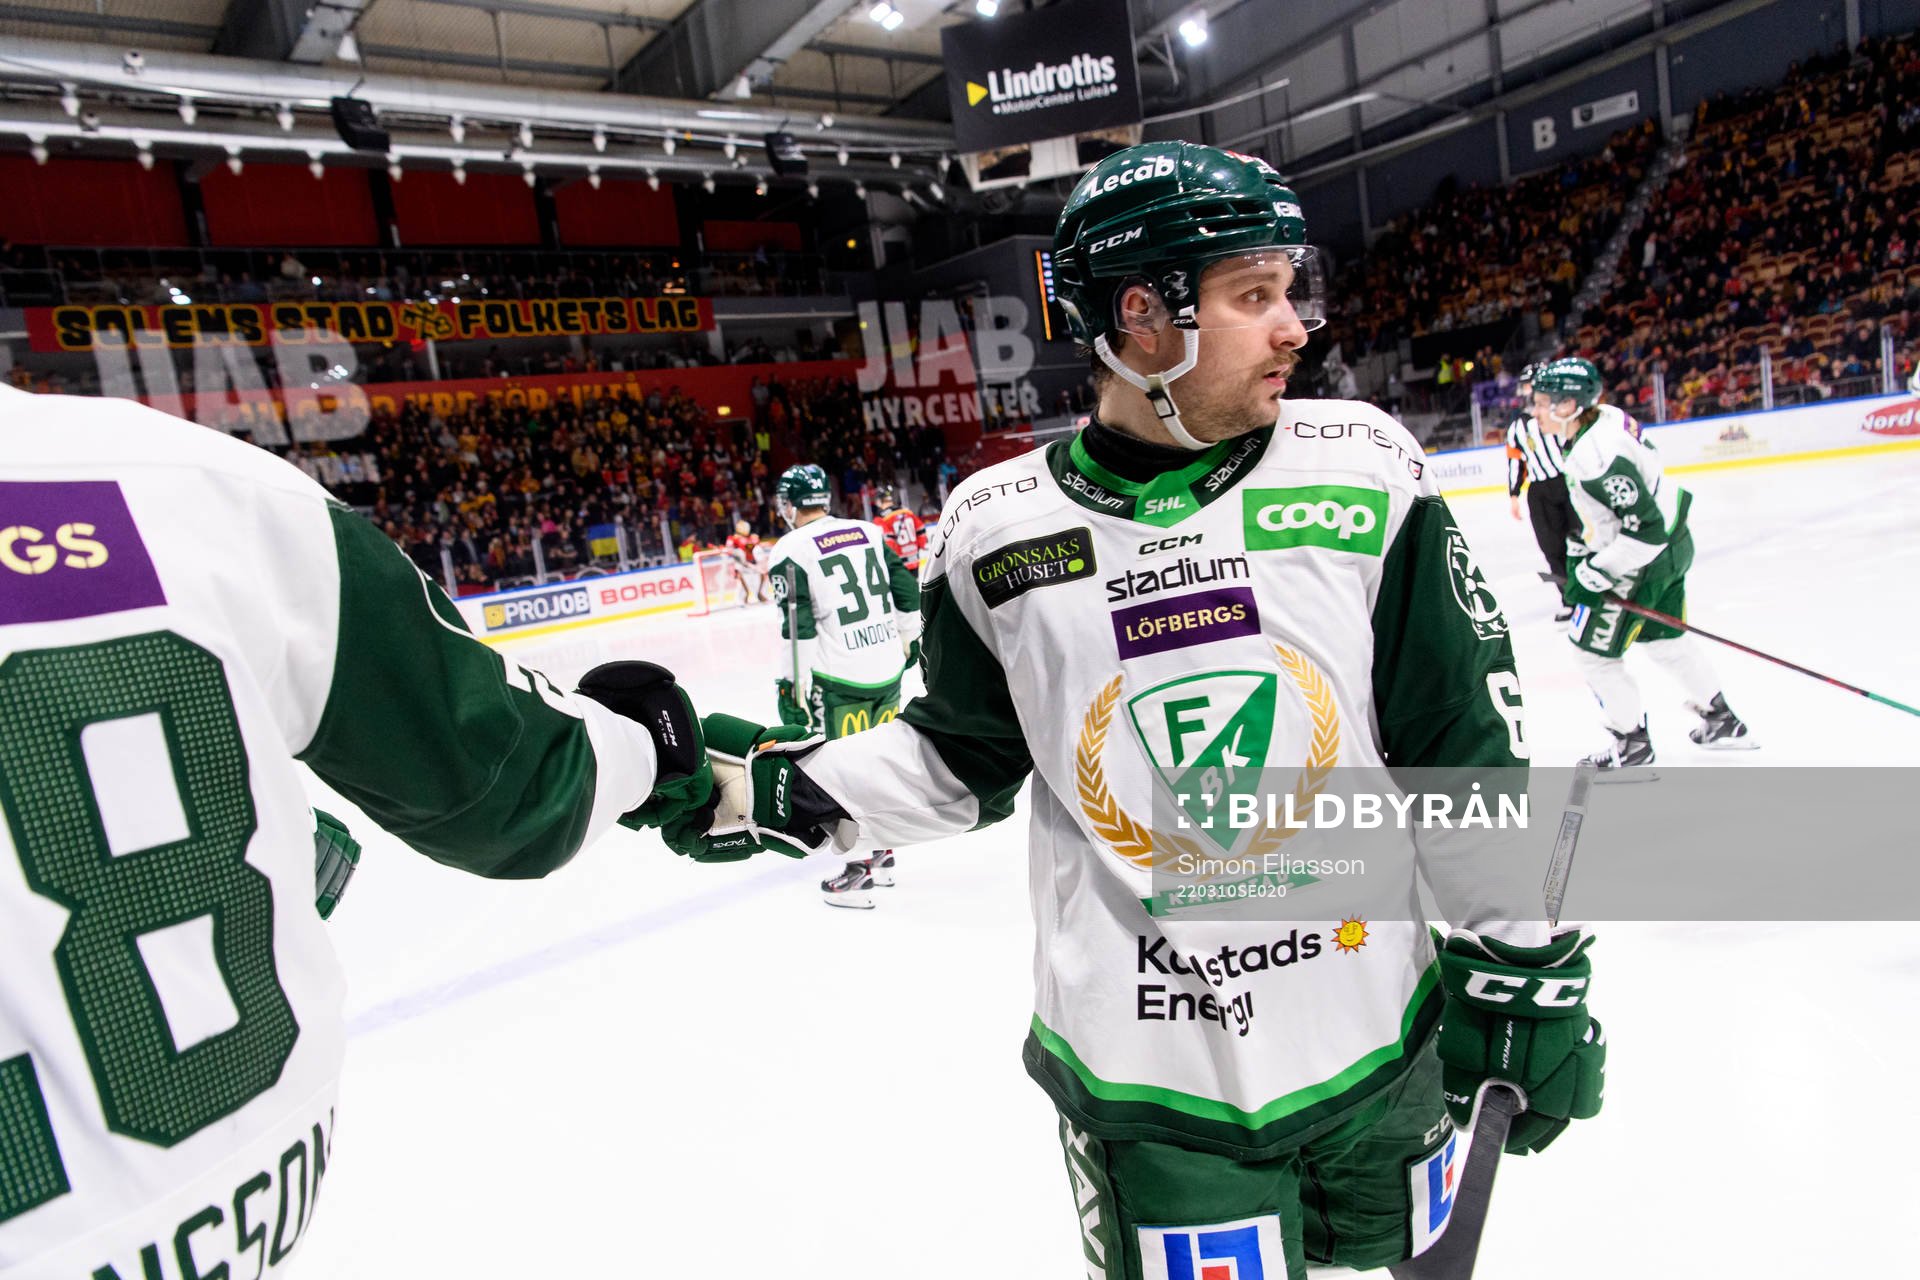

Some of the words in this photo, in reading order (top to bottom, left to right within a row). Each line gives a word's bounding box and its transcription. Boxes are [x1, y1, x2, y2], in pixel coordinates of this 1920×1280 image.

[986, 52, 1117, 102] Lindroths
[1532, 116, 1557, 152] B
[1088, 155, 1176, 199] Lecab
[1089, 226, 1144, 254] CCM
[54, 304, 264, 351] SOLENS
[270, 302, 397, 344] STAD
[456, 299, 628, 338] FOLKETS
[636, 296, 701, 334] LAG
[1172, 317, 1196, 327] CCM
[856, 296, 1035, 393] JIAB
[862, 380, 1042, 432] HYRCENTER
[1204, 436, 1262, 493] stadium
[1061, 471, 1126, 511] stadium
[1143, 494, 1187, 516] SHL
[1256, 500, 1377, 540] coop
[978, 537, 1081, 585] GRÖNSAKS
[1138, 533, 1204, 556] CCM
[600, 576, 694, 605] BORGA
[818, 547, 894, 627] 34
[1005, 557, 1068, 592] HUSET
[1105, 552, 1251, 604] stadium
[504, 589, 591, 626] PROJOB
[1125, 603, 1247, 642] LÖFBERGS
[775, 767, 789, 818] CCM
[0, 629, 301, 1224] 8
